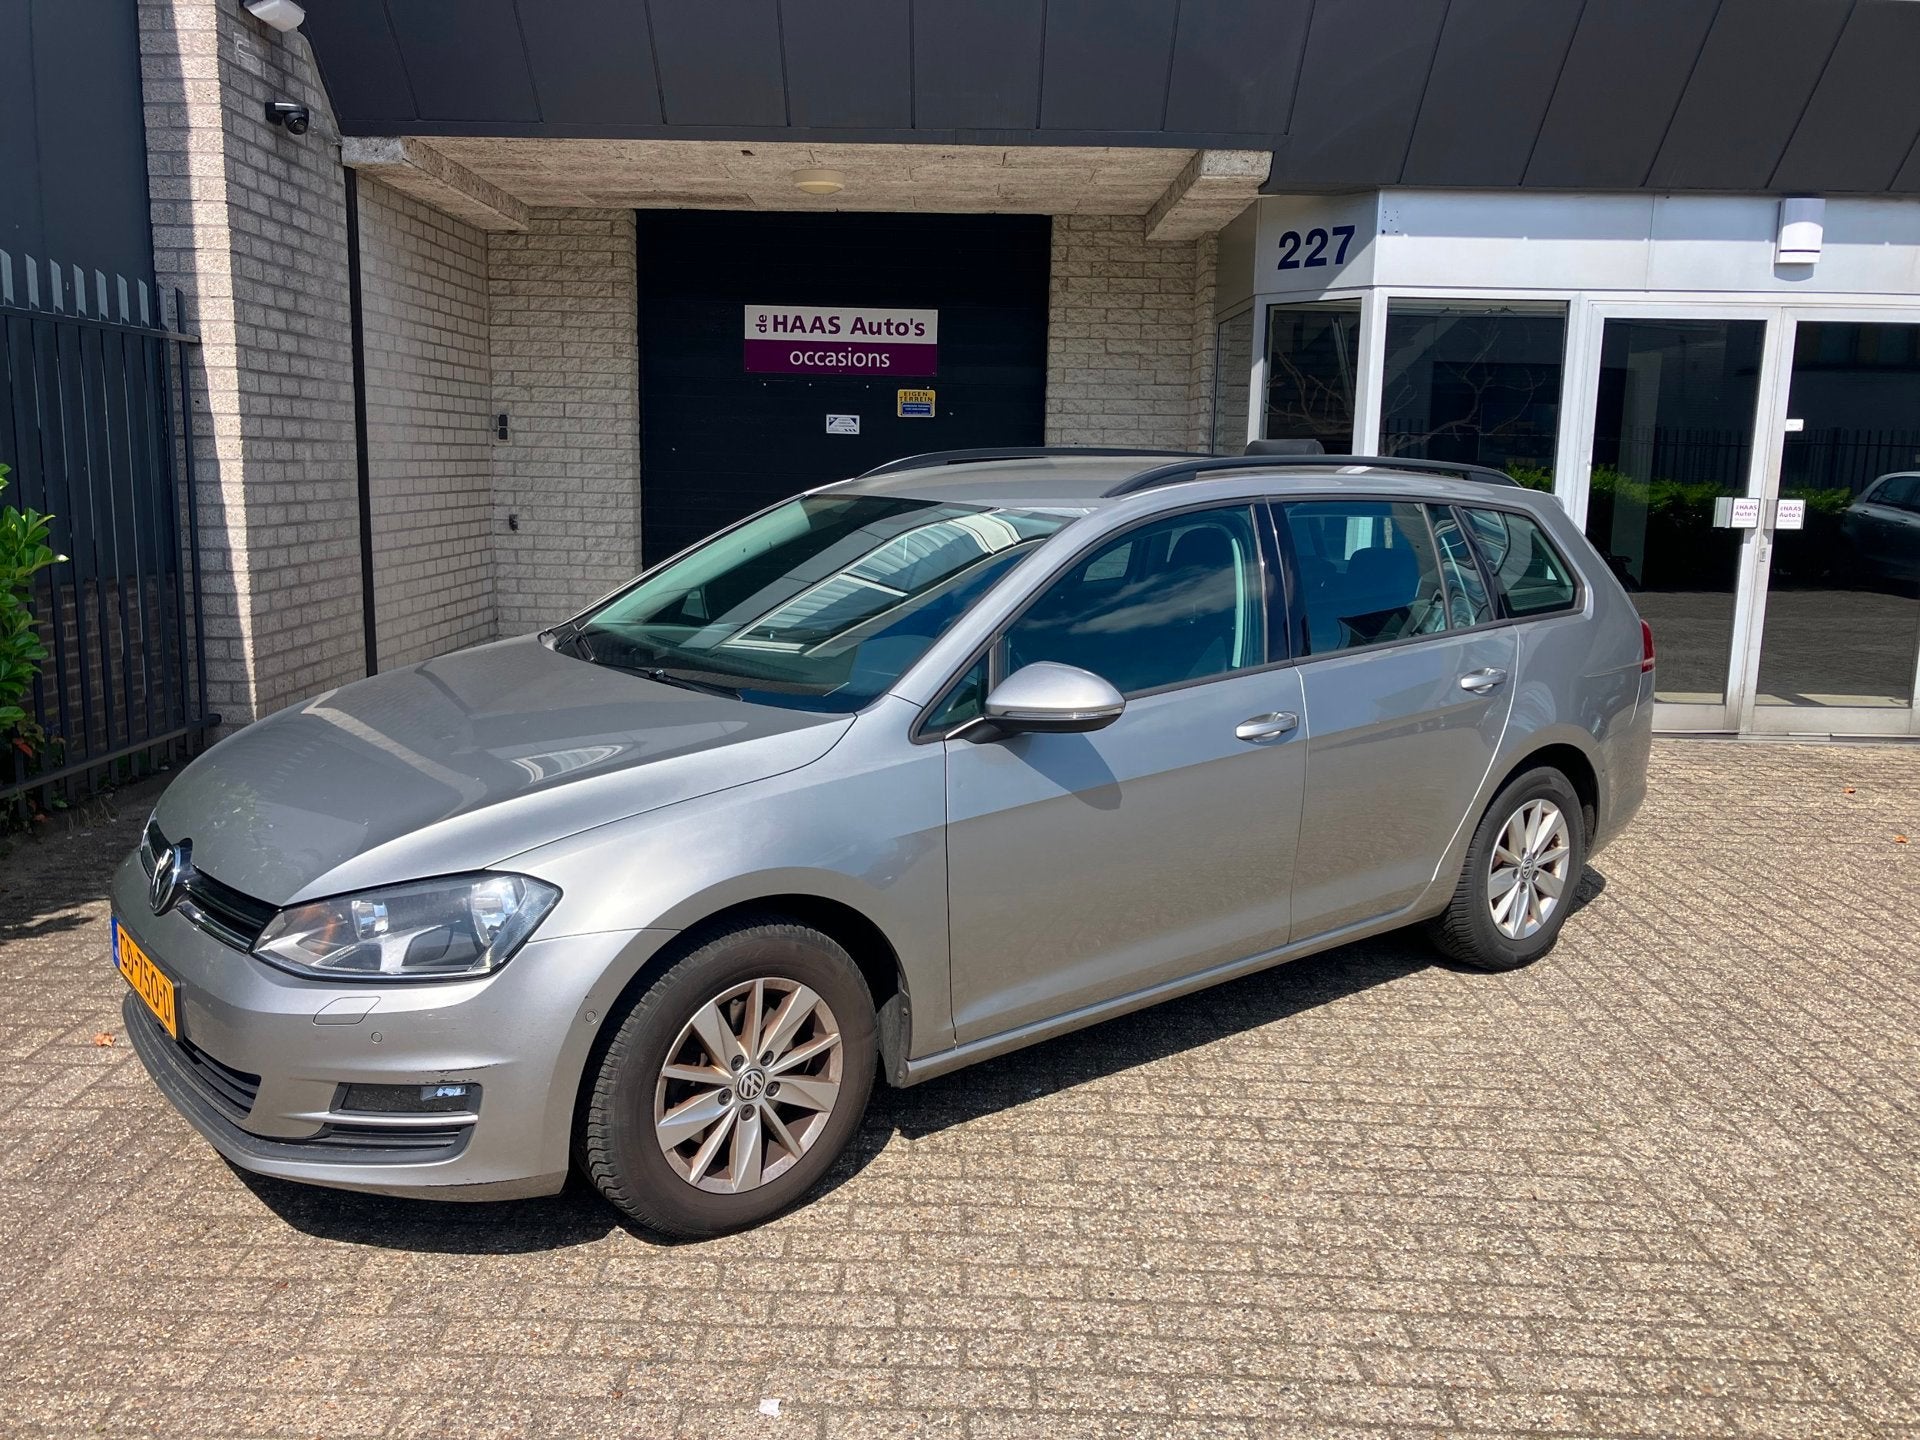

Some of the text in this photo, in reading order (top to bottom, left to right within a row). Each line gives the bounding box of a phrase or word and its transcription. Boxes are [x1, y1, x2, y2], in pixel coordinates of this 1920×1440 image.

[1278, 225, 1355, 270] 227
[755, 314, 926, 337] de HAAS Auto's
[790, 347, 890, 367] occasions
